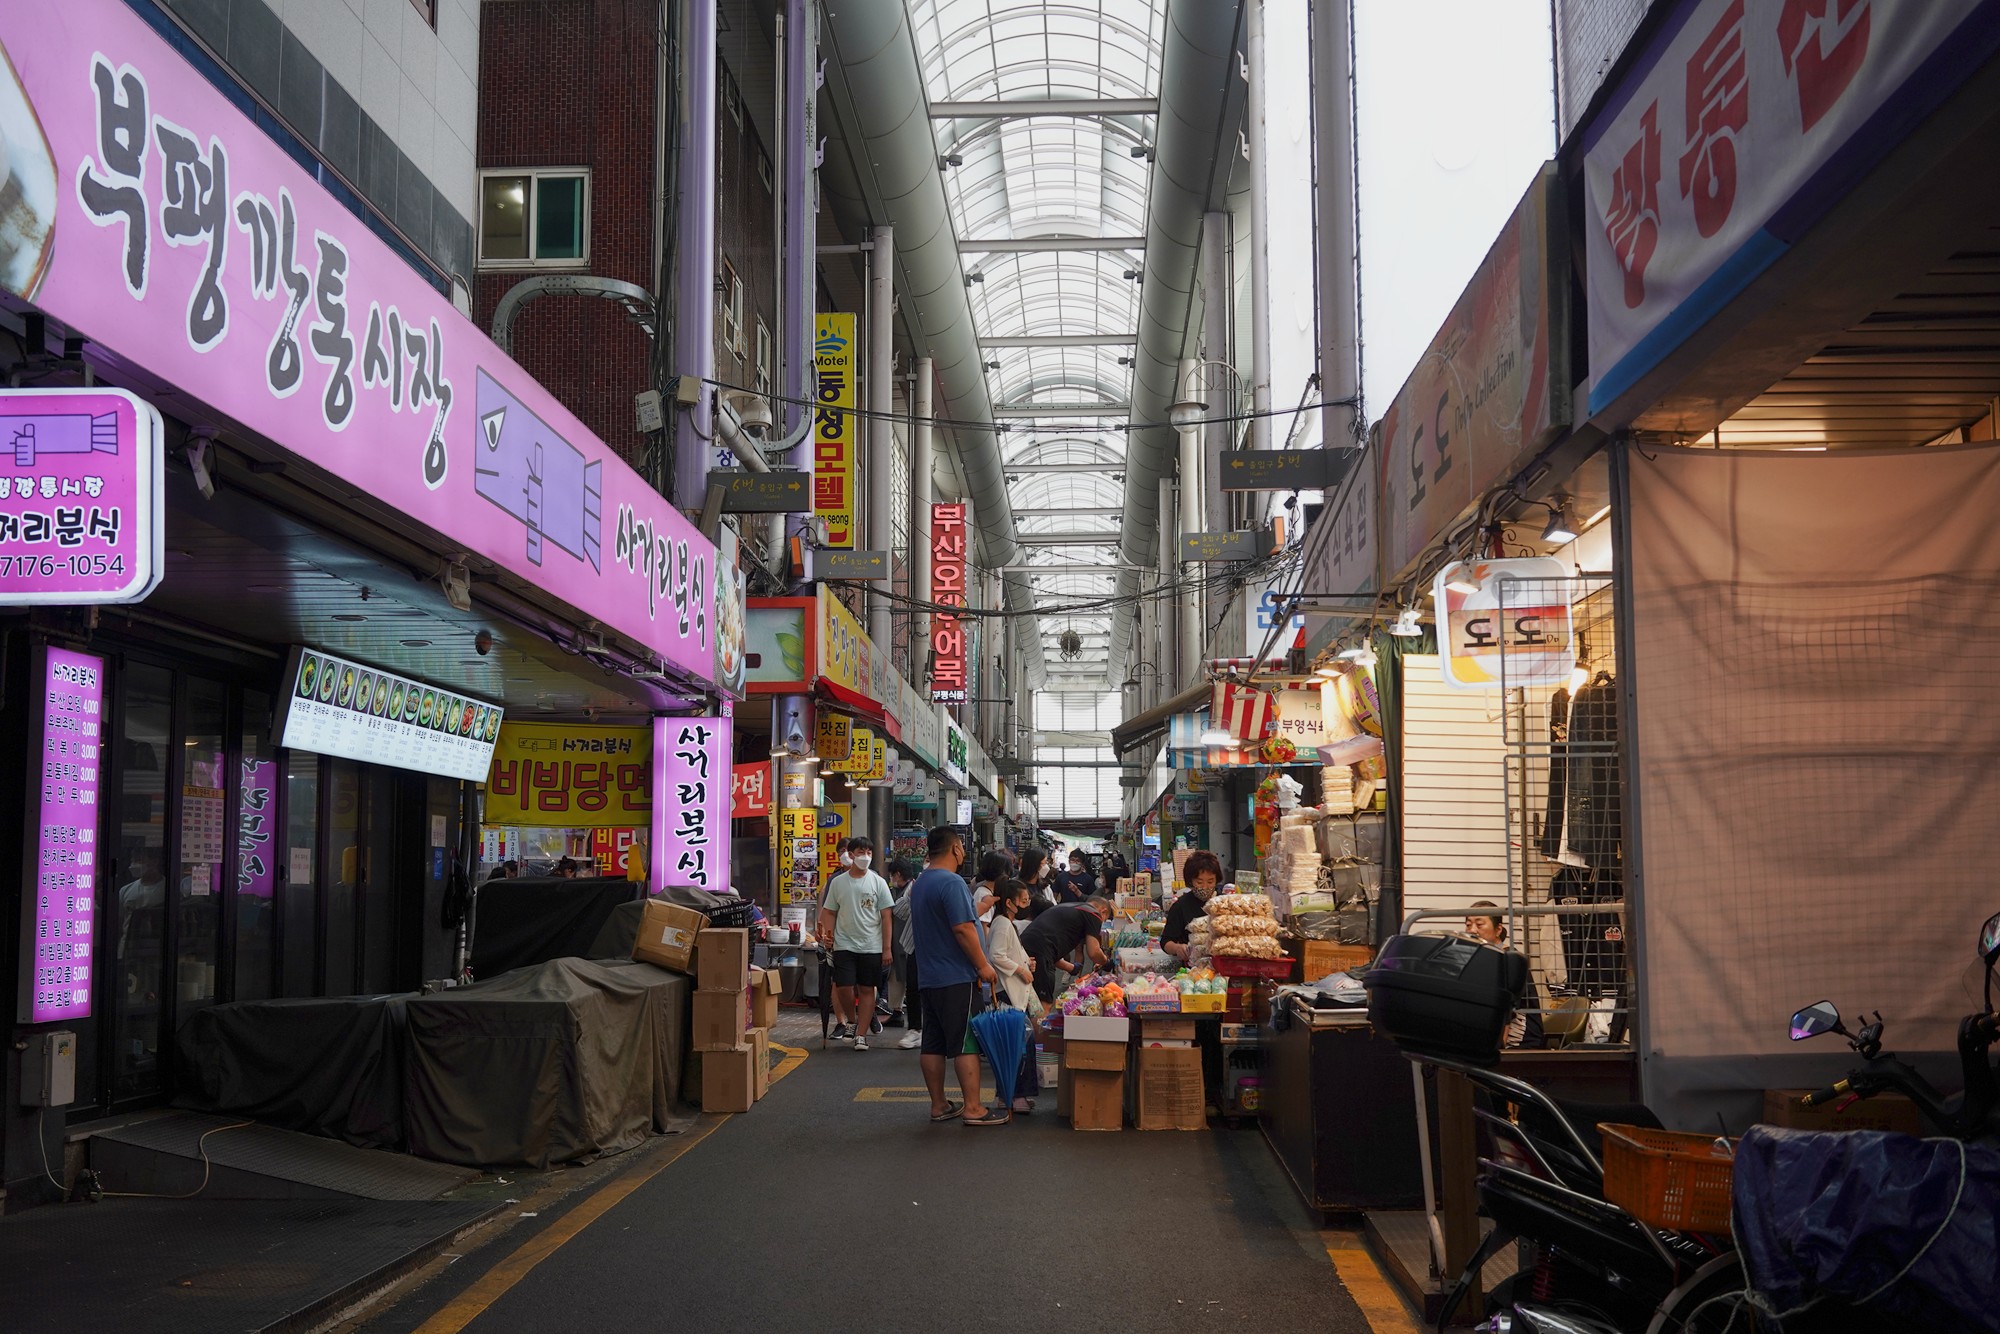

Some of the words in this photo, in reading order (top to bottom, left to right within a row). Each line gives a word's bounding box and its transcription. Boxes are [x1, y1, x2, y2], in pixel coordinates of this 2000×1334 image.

[78, 53, 452, 488] 부평깡통시장
[815, 355, 848, 366] Motel
[1411, 388, 1453, 512] 도도
[1476, 349, 1516, 409] Collection
[616, 502, 705, 652] 사거리분식
[932, 691, 964, 700] 부평식품
[83, 698, 99, 714] 4,000
[81, 722, 98, 737] 3,000
[820, 721, 847, 737] 맛집
[80, 745, 97, 760] 3,000
[562, 736, 633, 755] 사거리분식
[80, 767, 96, 782] 3,000
[79, 790, 95, 805] 3,000
[674, 724, 713, 887] 사거리분식
[44, 825, 77, 843] 비빔당면
[78, 828, 94, 843] 4,000
[42, 848, 76, 866] 잔치국수
[77, 851, 93, 866] 4,000
[42, 872, 75, 890] 비빔국수
[76, 875, 92, 889] 5,000
[75, 897, 91, 912] 4,500
[74, 920, 90, 934] 5,000
[73, 943, 90, 958] 5,500
[73, 966, 89, 980] 5,000
[72, 989, 88, 1004] 4,000
